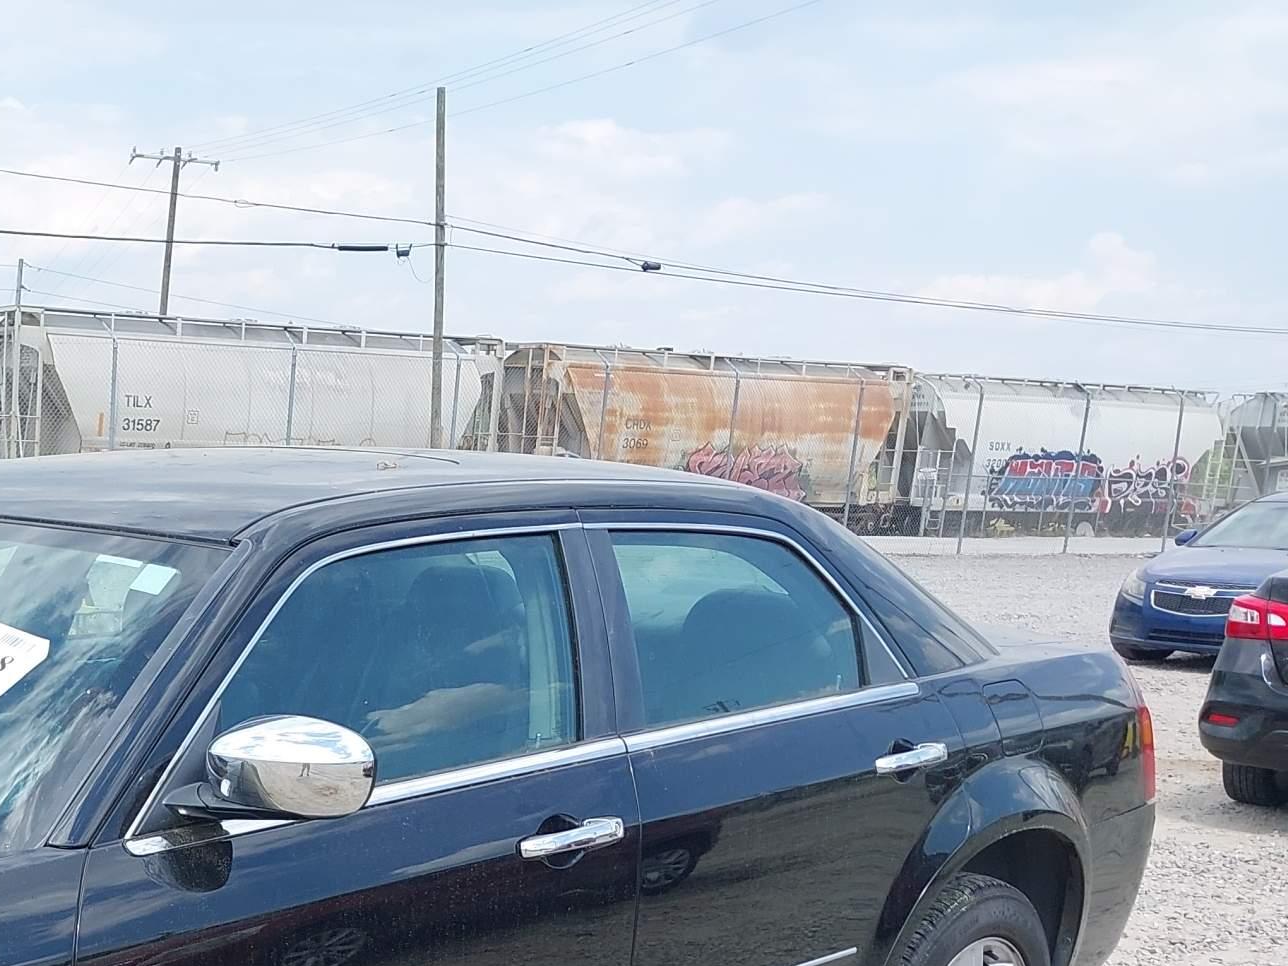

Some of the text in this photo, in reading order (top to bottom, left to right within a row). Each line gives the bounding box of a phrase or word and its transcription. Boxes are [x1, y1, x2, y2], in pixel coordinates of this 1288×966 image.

[124, 394, 153, 408] TILX
[121, 417, 161, 432] 31587
[622, 437, 649, 449] 3069
[988, 441, 1012, 452] SOXX
